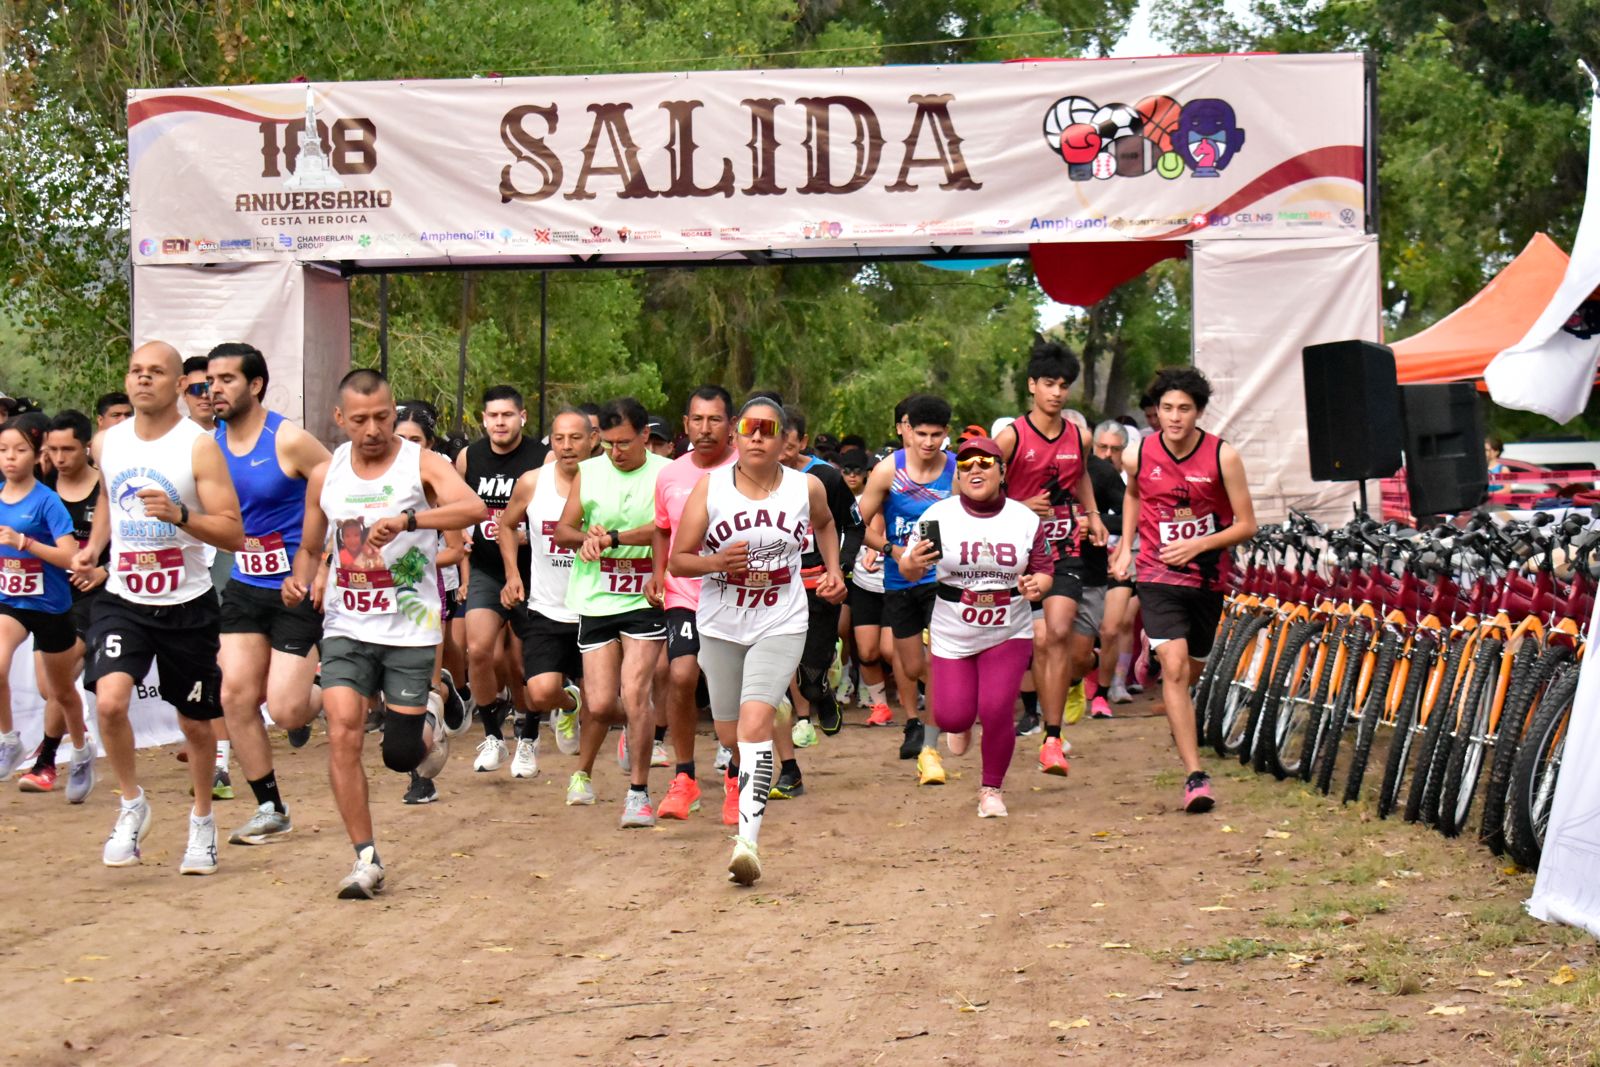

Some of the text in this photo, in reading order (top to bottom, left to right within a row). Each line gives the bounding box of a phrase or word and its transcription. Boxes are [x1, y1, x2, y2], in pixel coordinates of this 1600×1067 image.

[499, 94, 983, 204] SALIDA
[235, 189, 393, 212] ANIVERSARIO
[261, 213, 368, 226] GESTA HEROICA
[1030, 216, 1108, 231] Amphenol
[296, 234, 354, 243] CHAMBERLAIN
[296, 242, 325, 250] GROUP
[119, 520, 177, 538] CASTRO
[705, 508, 804, 554] NOGALE
[1044, 521, 1068, 539] 25
[1167, 518, 1209, 542] 303
[241, 552, 280, 574] 188
[126, 569, 180, 595] 001
[608, 574, 644, 593] 121
[343, 589, 391, 613] 054
[735, 586, 781, 609] 176
[961, 607, 1007, 626] 002
[680, 621, 694, 640] 4
[105, 634, 123, 658] 5
[136, 684, 161, 699] Ba
